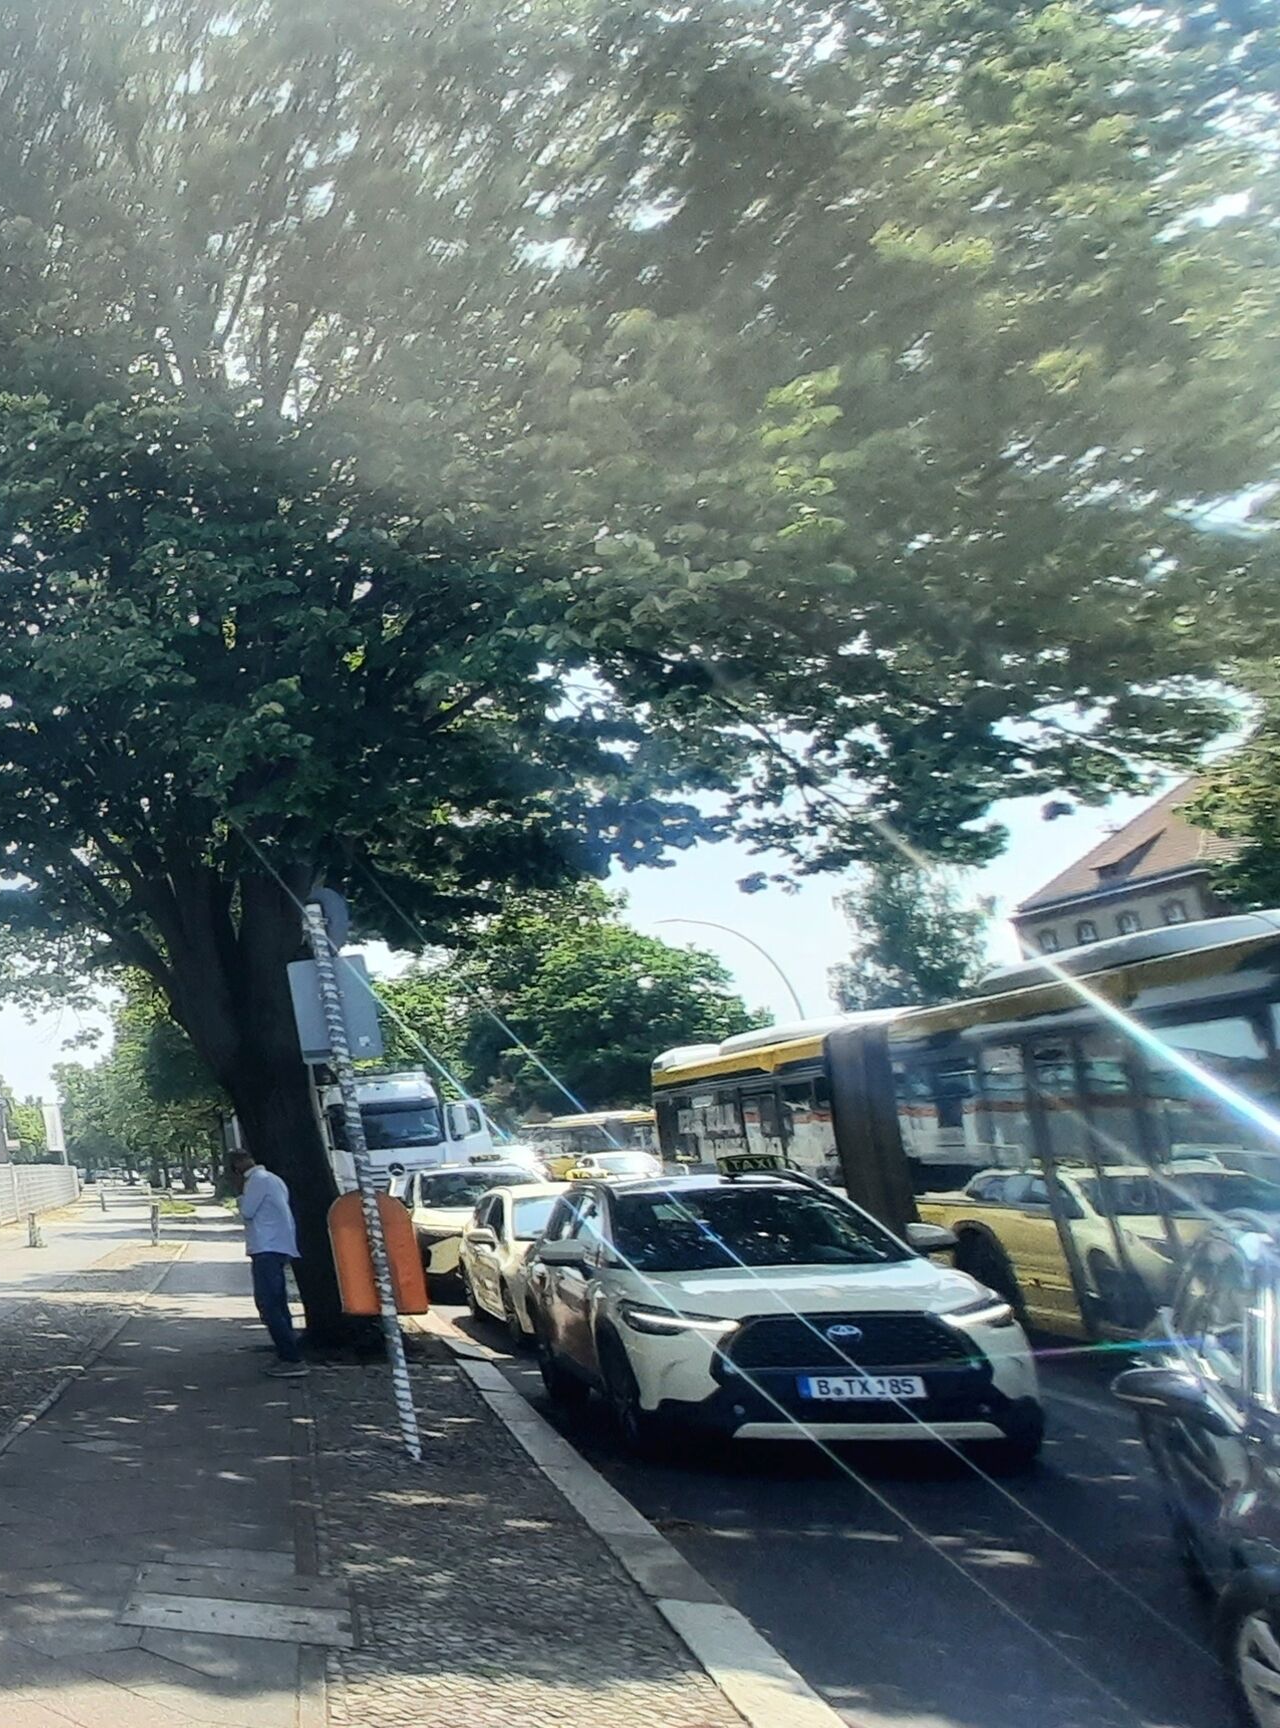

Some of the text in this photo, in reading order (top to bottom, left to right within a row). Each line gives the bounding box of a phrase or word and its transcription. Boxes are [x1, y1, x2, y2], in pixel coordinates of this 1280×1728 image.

[730, 1156, 775, 1171] TAXI
[816, 1378, 916, 1396] B TX 185
